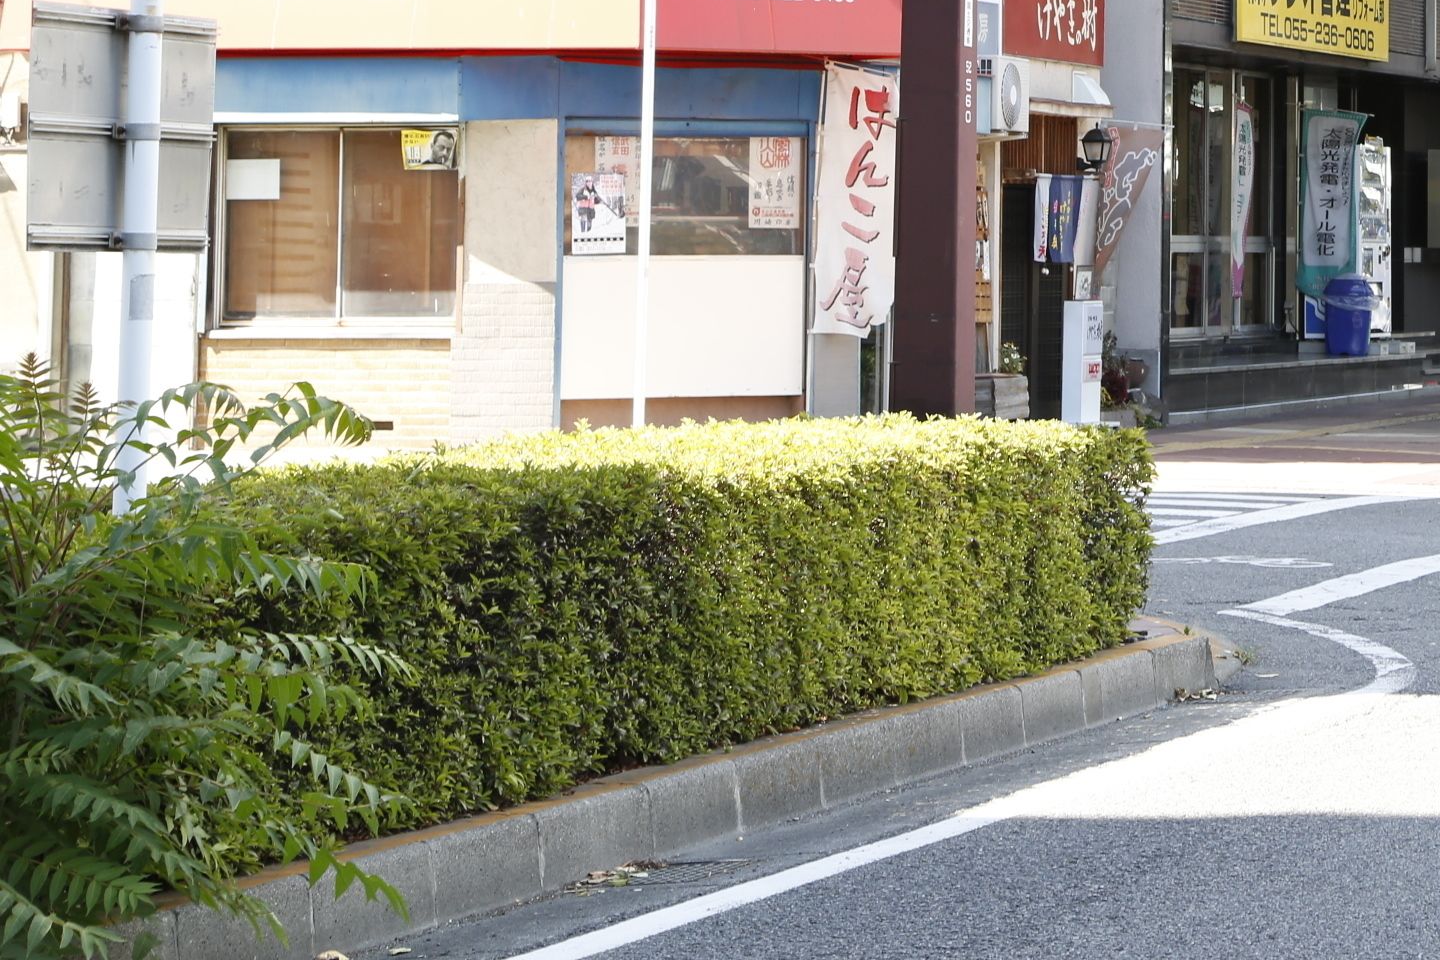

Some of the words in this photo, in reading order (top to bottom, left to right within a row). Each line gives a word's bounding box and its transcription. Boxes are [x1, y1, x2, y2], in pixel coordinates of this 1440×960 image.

[1284, 16, 1374, 52] 055-236-0606
[820, 86, 896, 328] はんこ屋
[1317, 128, 1342, 257] 太陽光発電・オール電化
